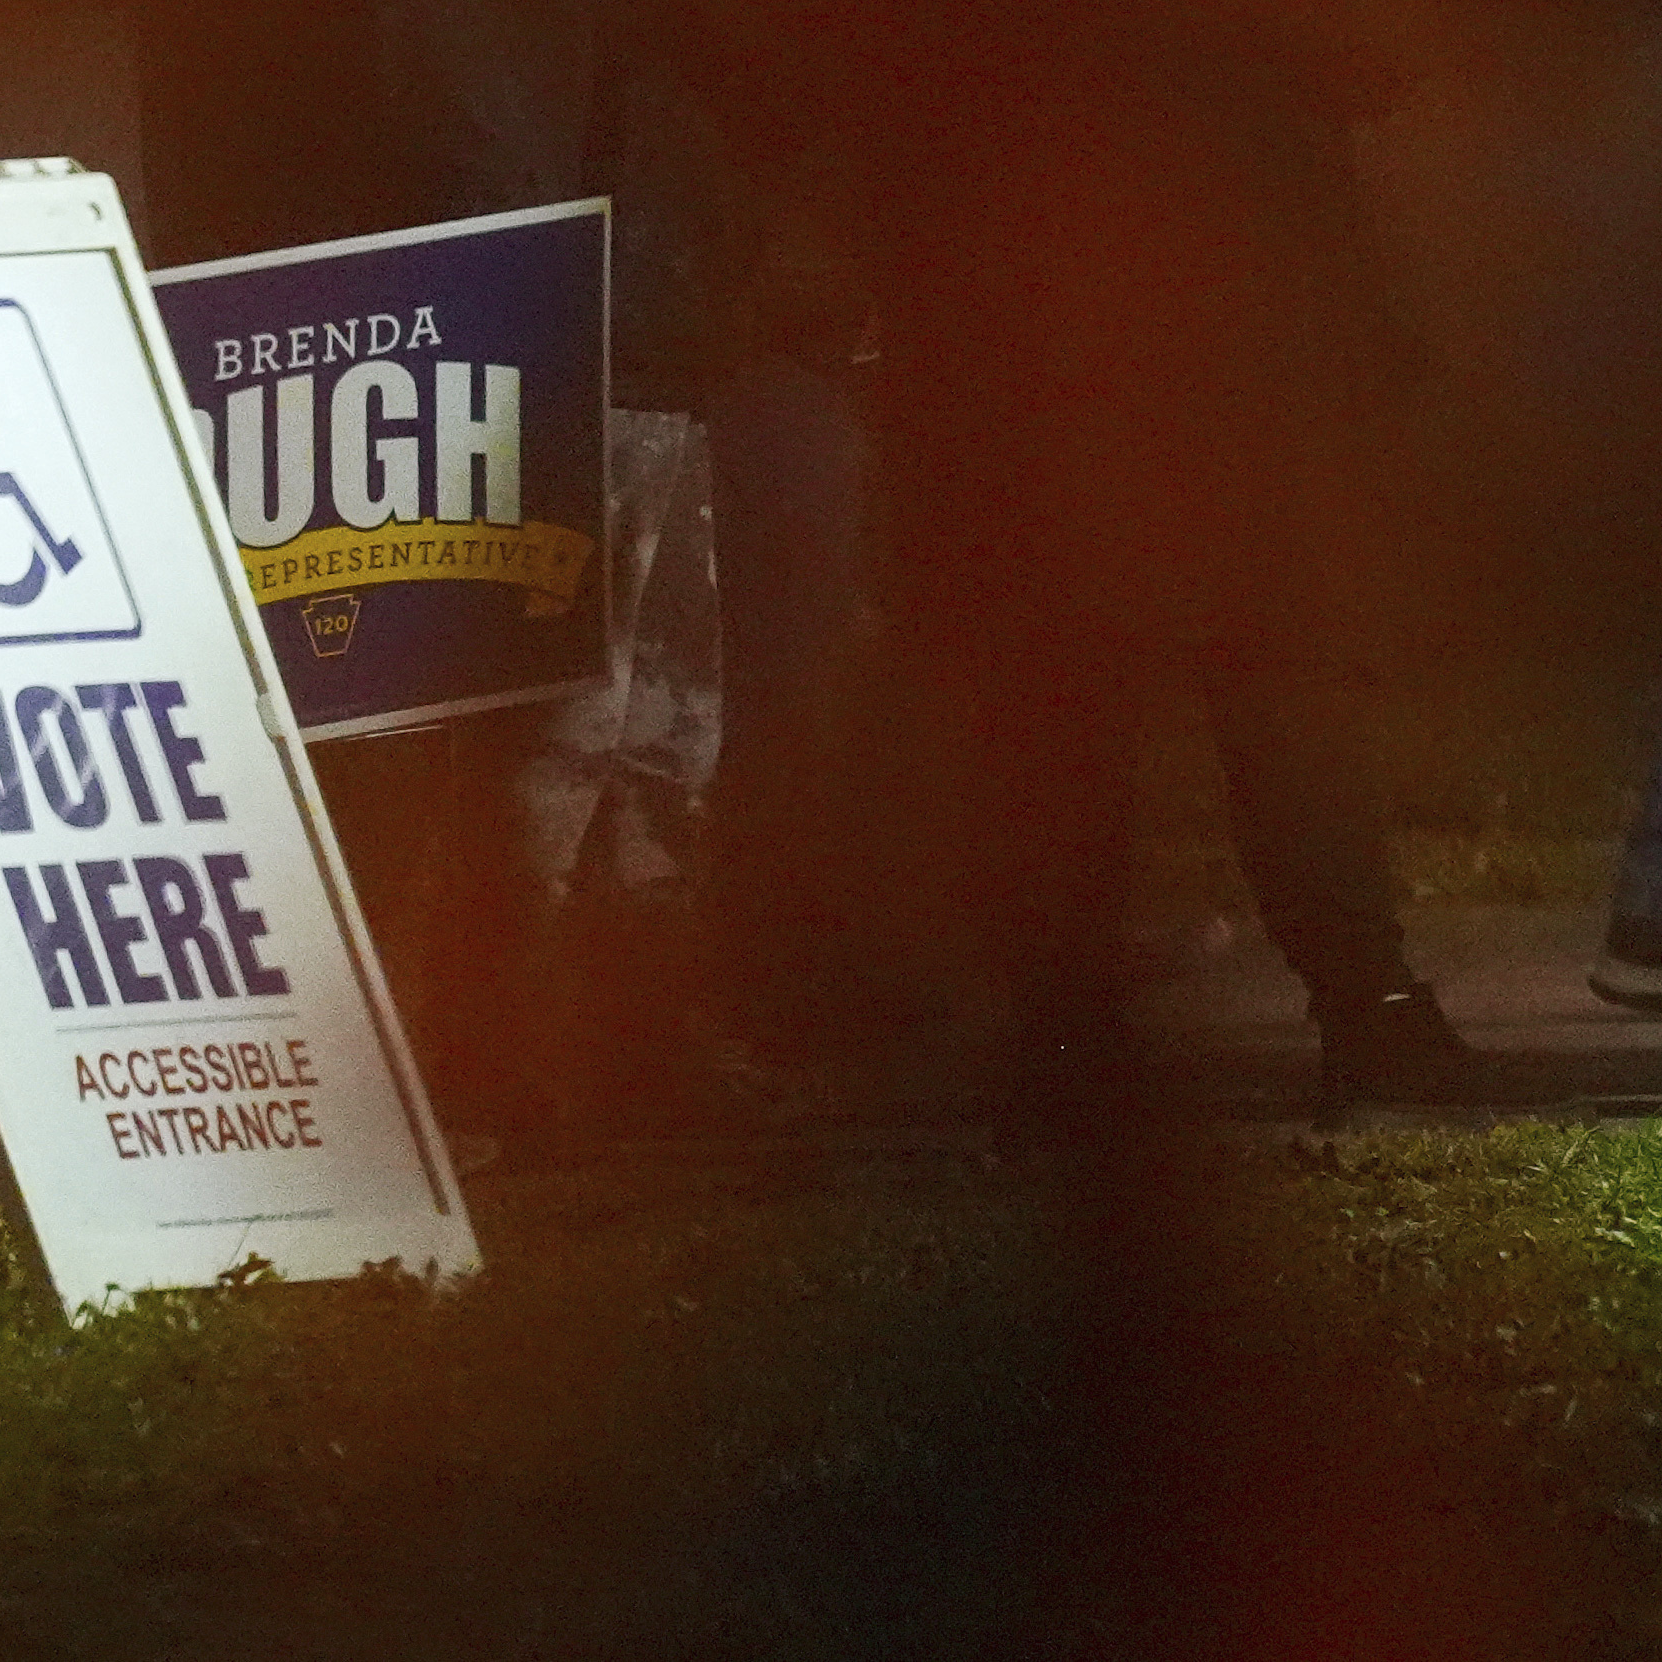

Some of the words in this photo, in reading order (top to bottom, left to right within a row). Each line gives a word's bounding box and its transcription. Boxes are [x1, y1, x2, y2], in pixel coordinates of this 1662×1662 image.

[214, 305, 442, 381] BRENDA
[191, 360, 522, 549] UGH
[314, 615, 349, 636] 120
[1, 852, 290, 1009] HERE
[75, 1039, 319, 1102] ACCESSIBLE
[105, 1102, 323, 1160] ENTRANCE
